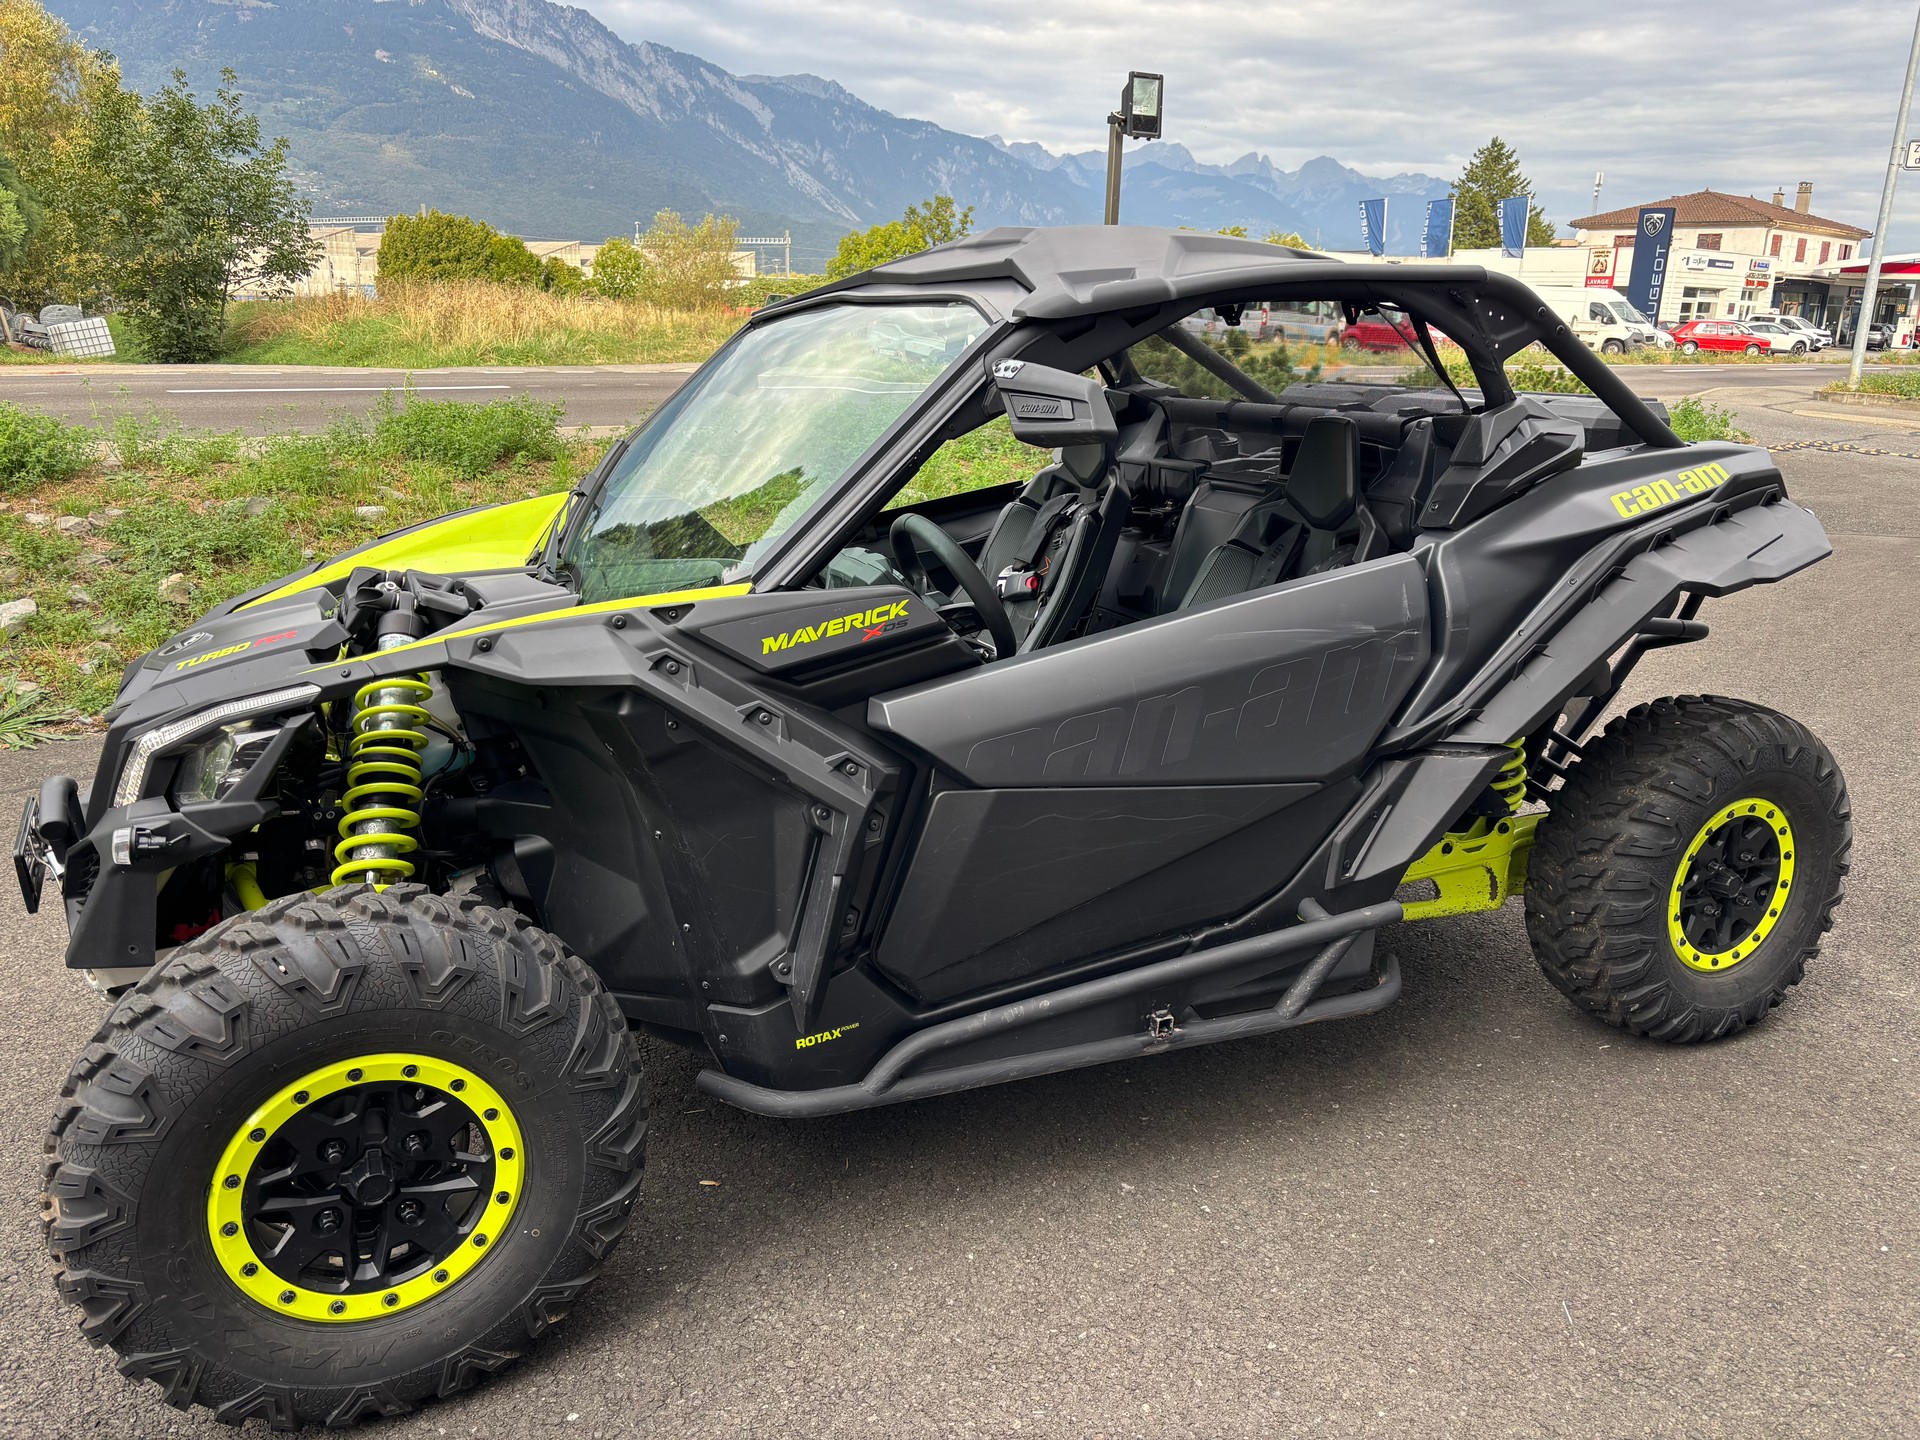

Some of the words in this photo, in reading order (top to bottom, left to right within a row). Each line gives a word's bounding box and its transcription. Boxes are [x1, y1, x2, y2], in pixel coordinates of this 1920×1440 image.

[1647, 244, 1666, 326] EUGEOT
[1018, 403, 1059, 414] can-am
[1610, 462, 1730, 518] can-am
[761, 598, 910, 655] MAVERICK
[176, 641, 252, 671] TURBO
[796, 1027, 842, 1049] ROTAX
[841, 1022, 860, 1032] POWER
